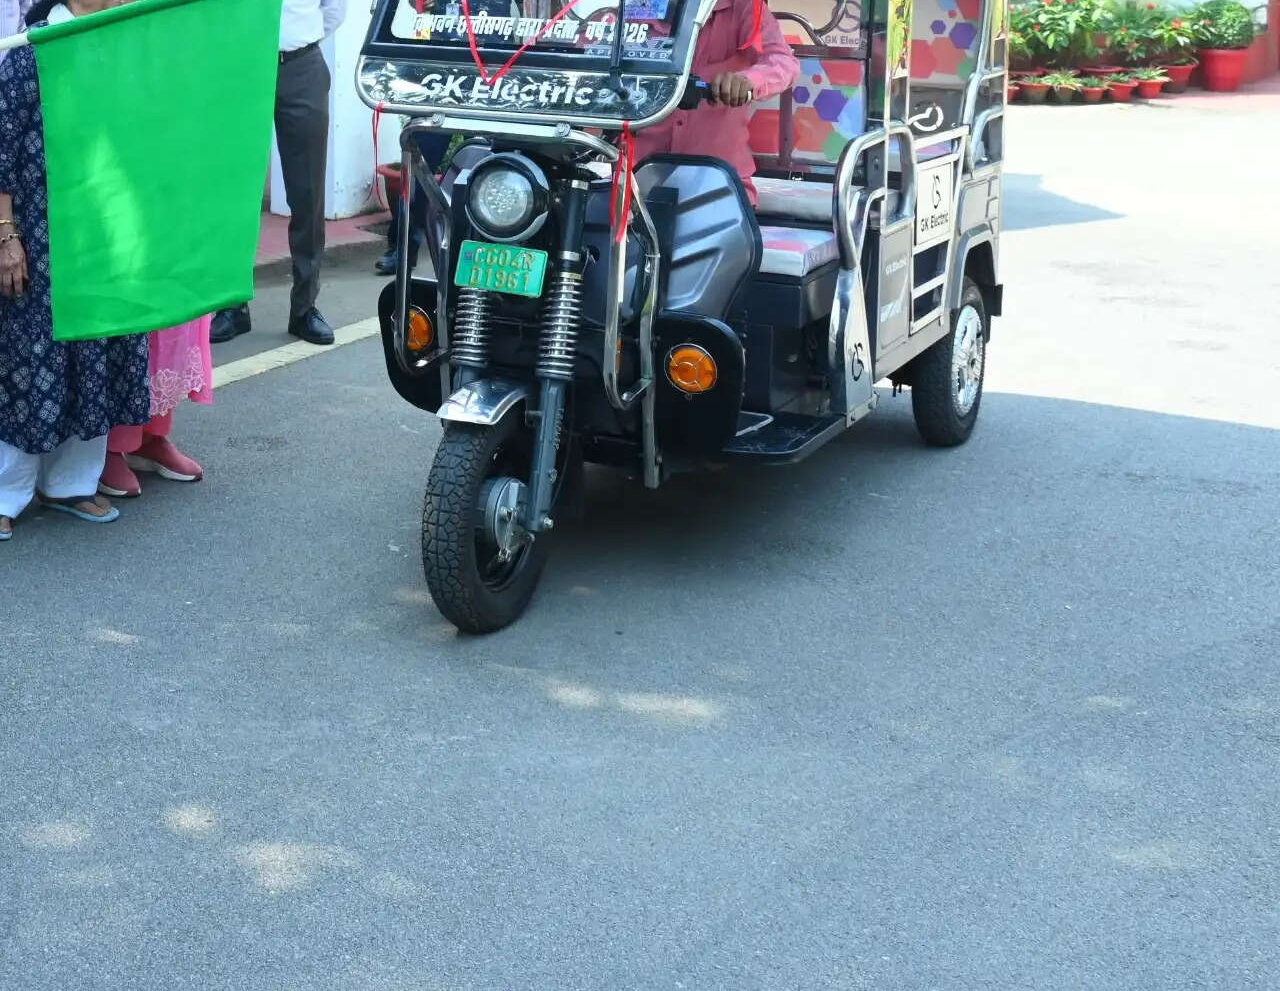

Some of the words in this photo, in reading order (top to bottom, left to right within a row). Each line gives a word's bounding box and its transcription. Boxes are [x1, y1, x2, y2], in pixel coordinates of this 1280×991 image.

[586, 48, 668, 59] APPOVED
[420, 73, 467, 98] GK
[471, 75, 594, 106] Electric
[930, 212, 948, 229] Electric
[474, 246, 537, 272] CG04R
[469, 266, 529, 291] D1961
